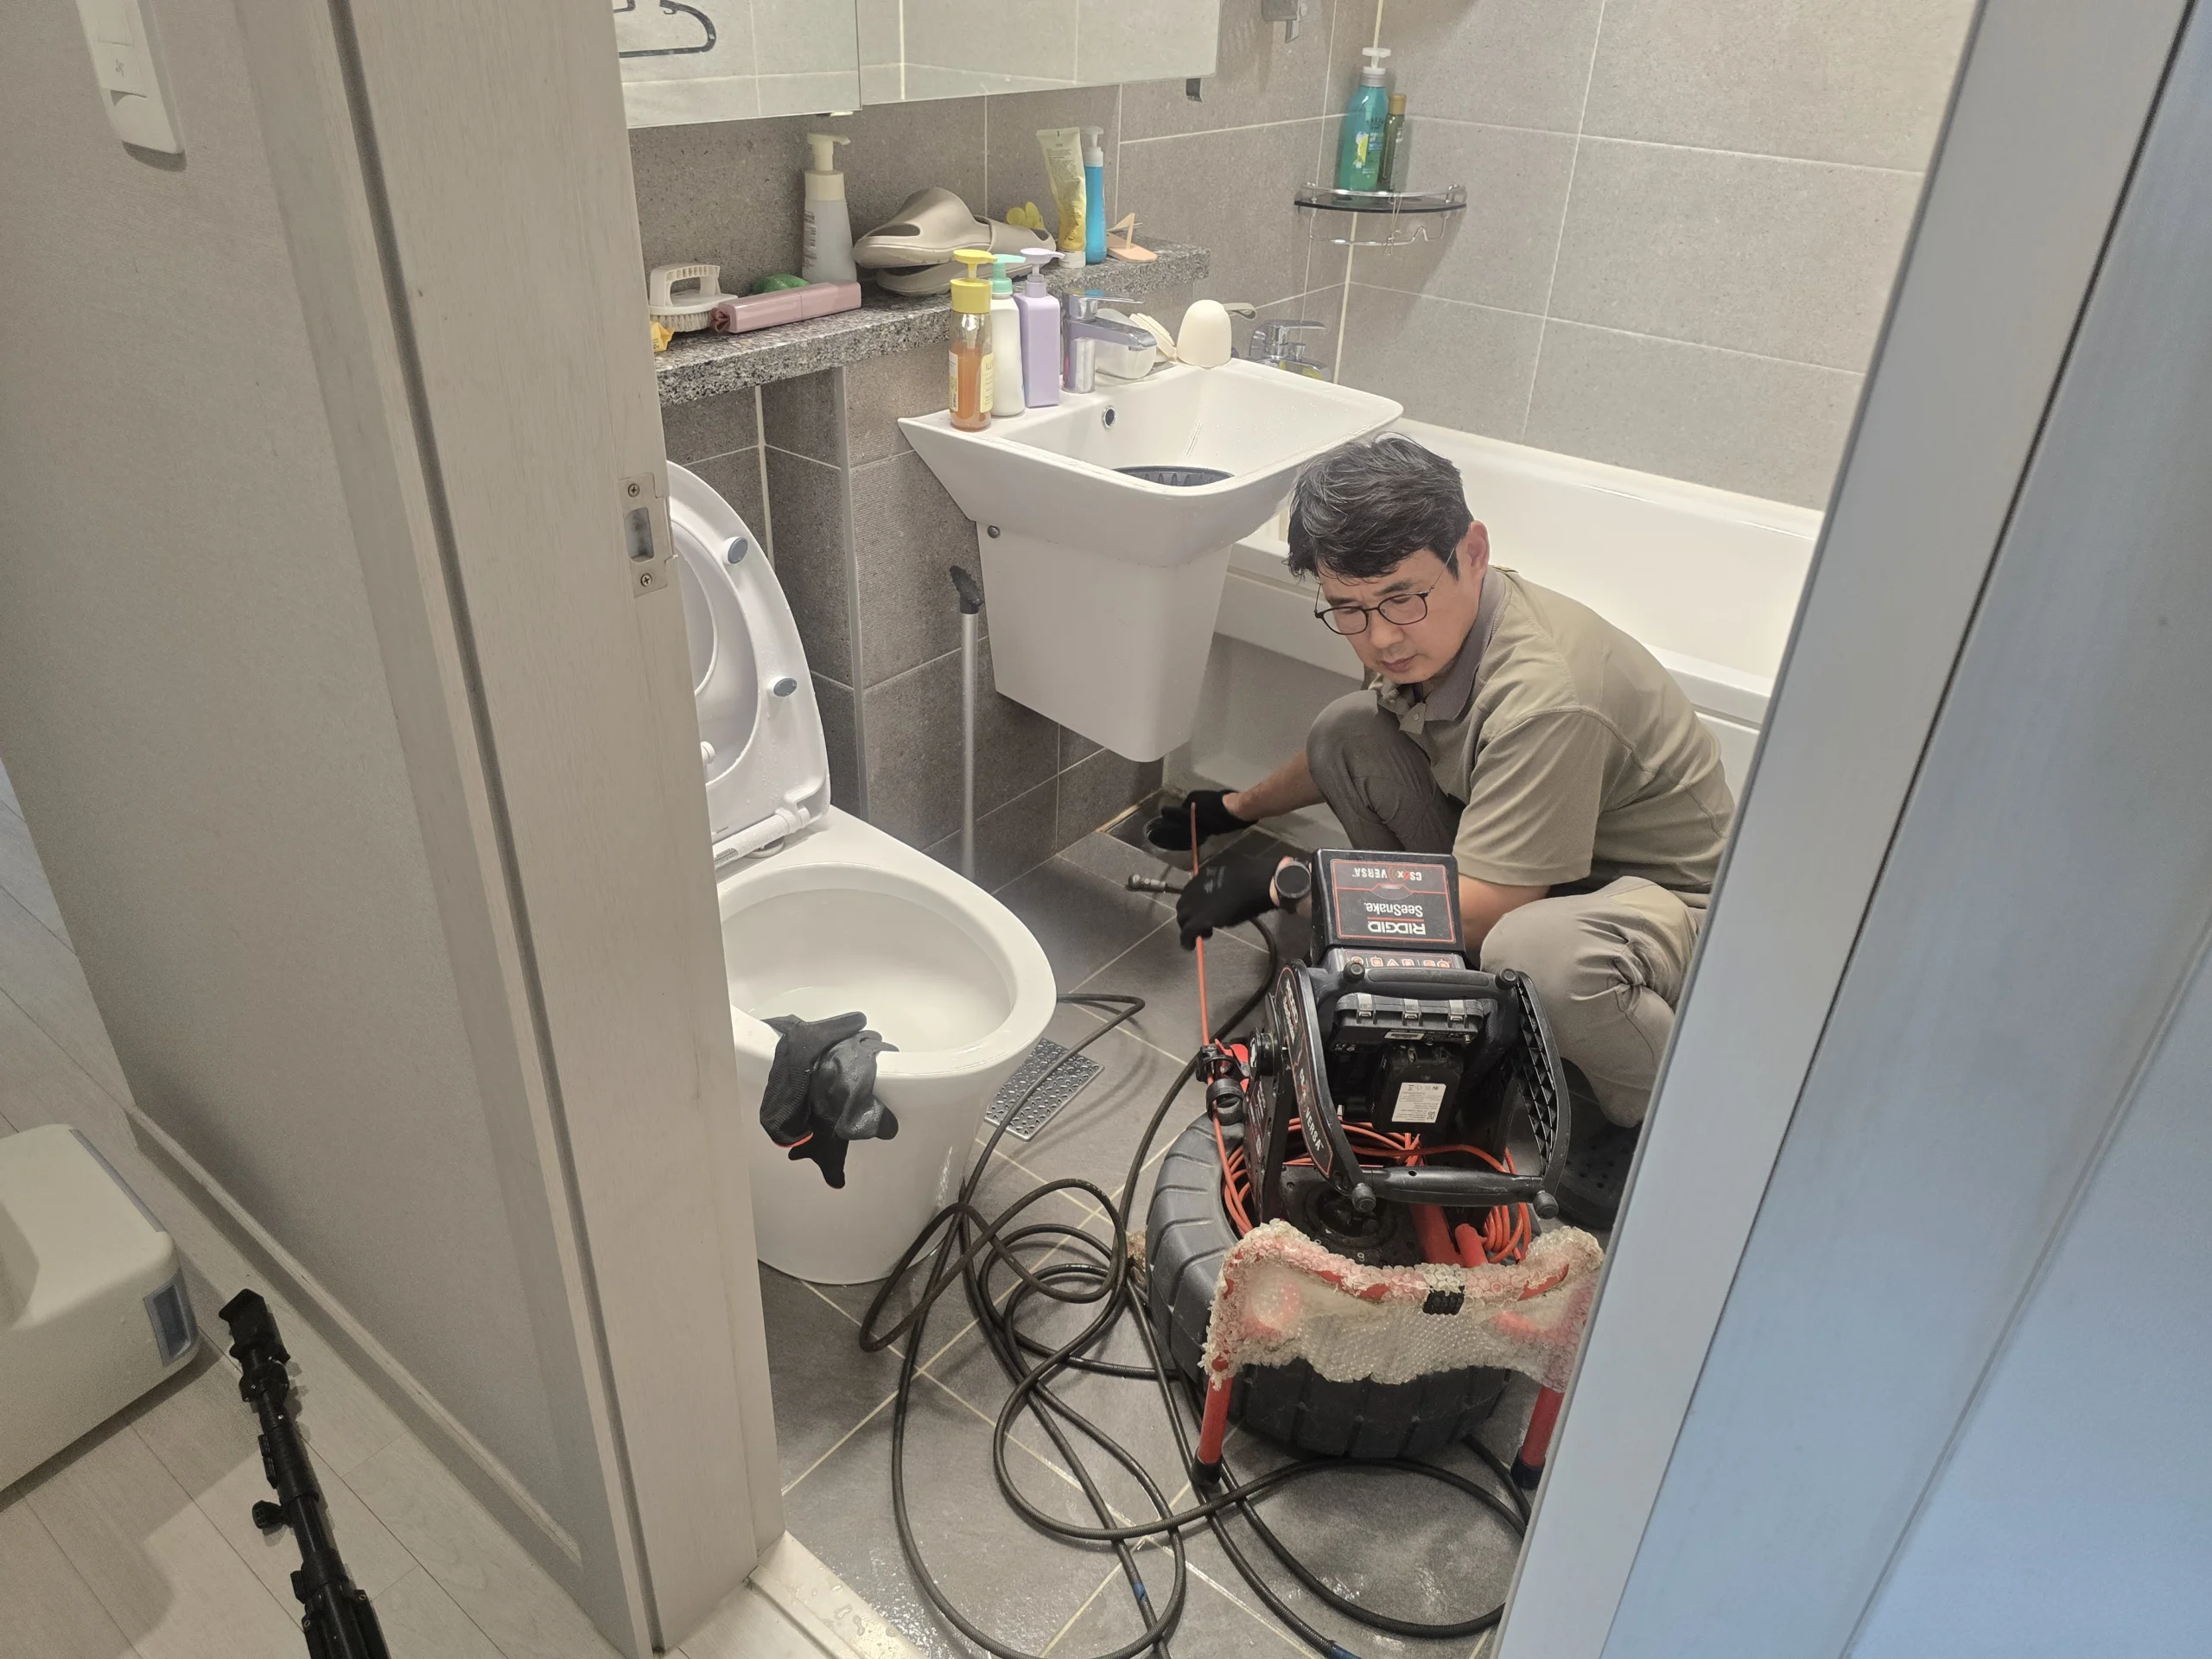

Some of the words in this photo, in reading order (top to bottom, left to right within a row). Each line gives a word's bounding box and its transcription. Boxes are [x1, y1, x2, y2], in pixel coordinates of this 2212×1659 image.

[1354, 867, 1388, 879] VERSA
[1365, 902, 1424, 918] SeeSnake
[1367, 920, 1427, 936] RIDGID
[1306, 1107, 1321, 1151] VERSA
